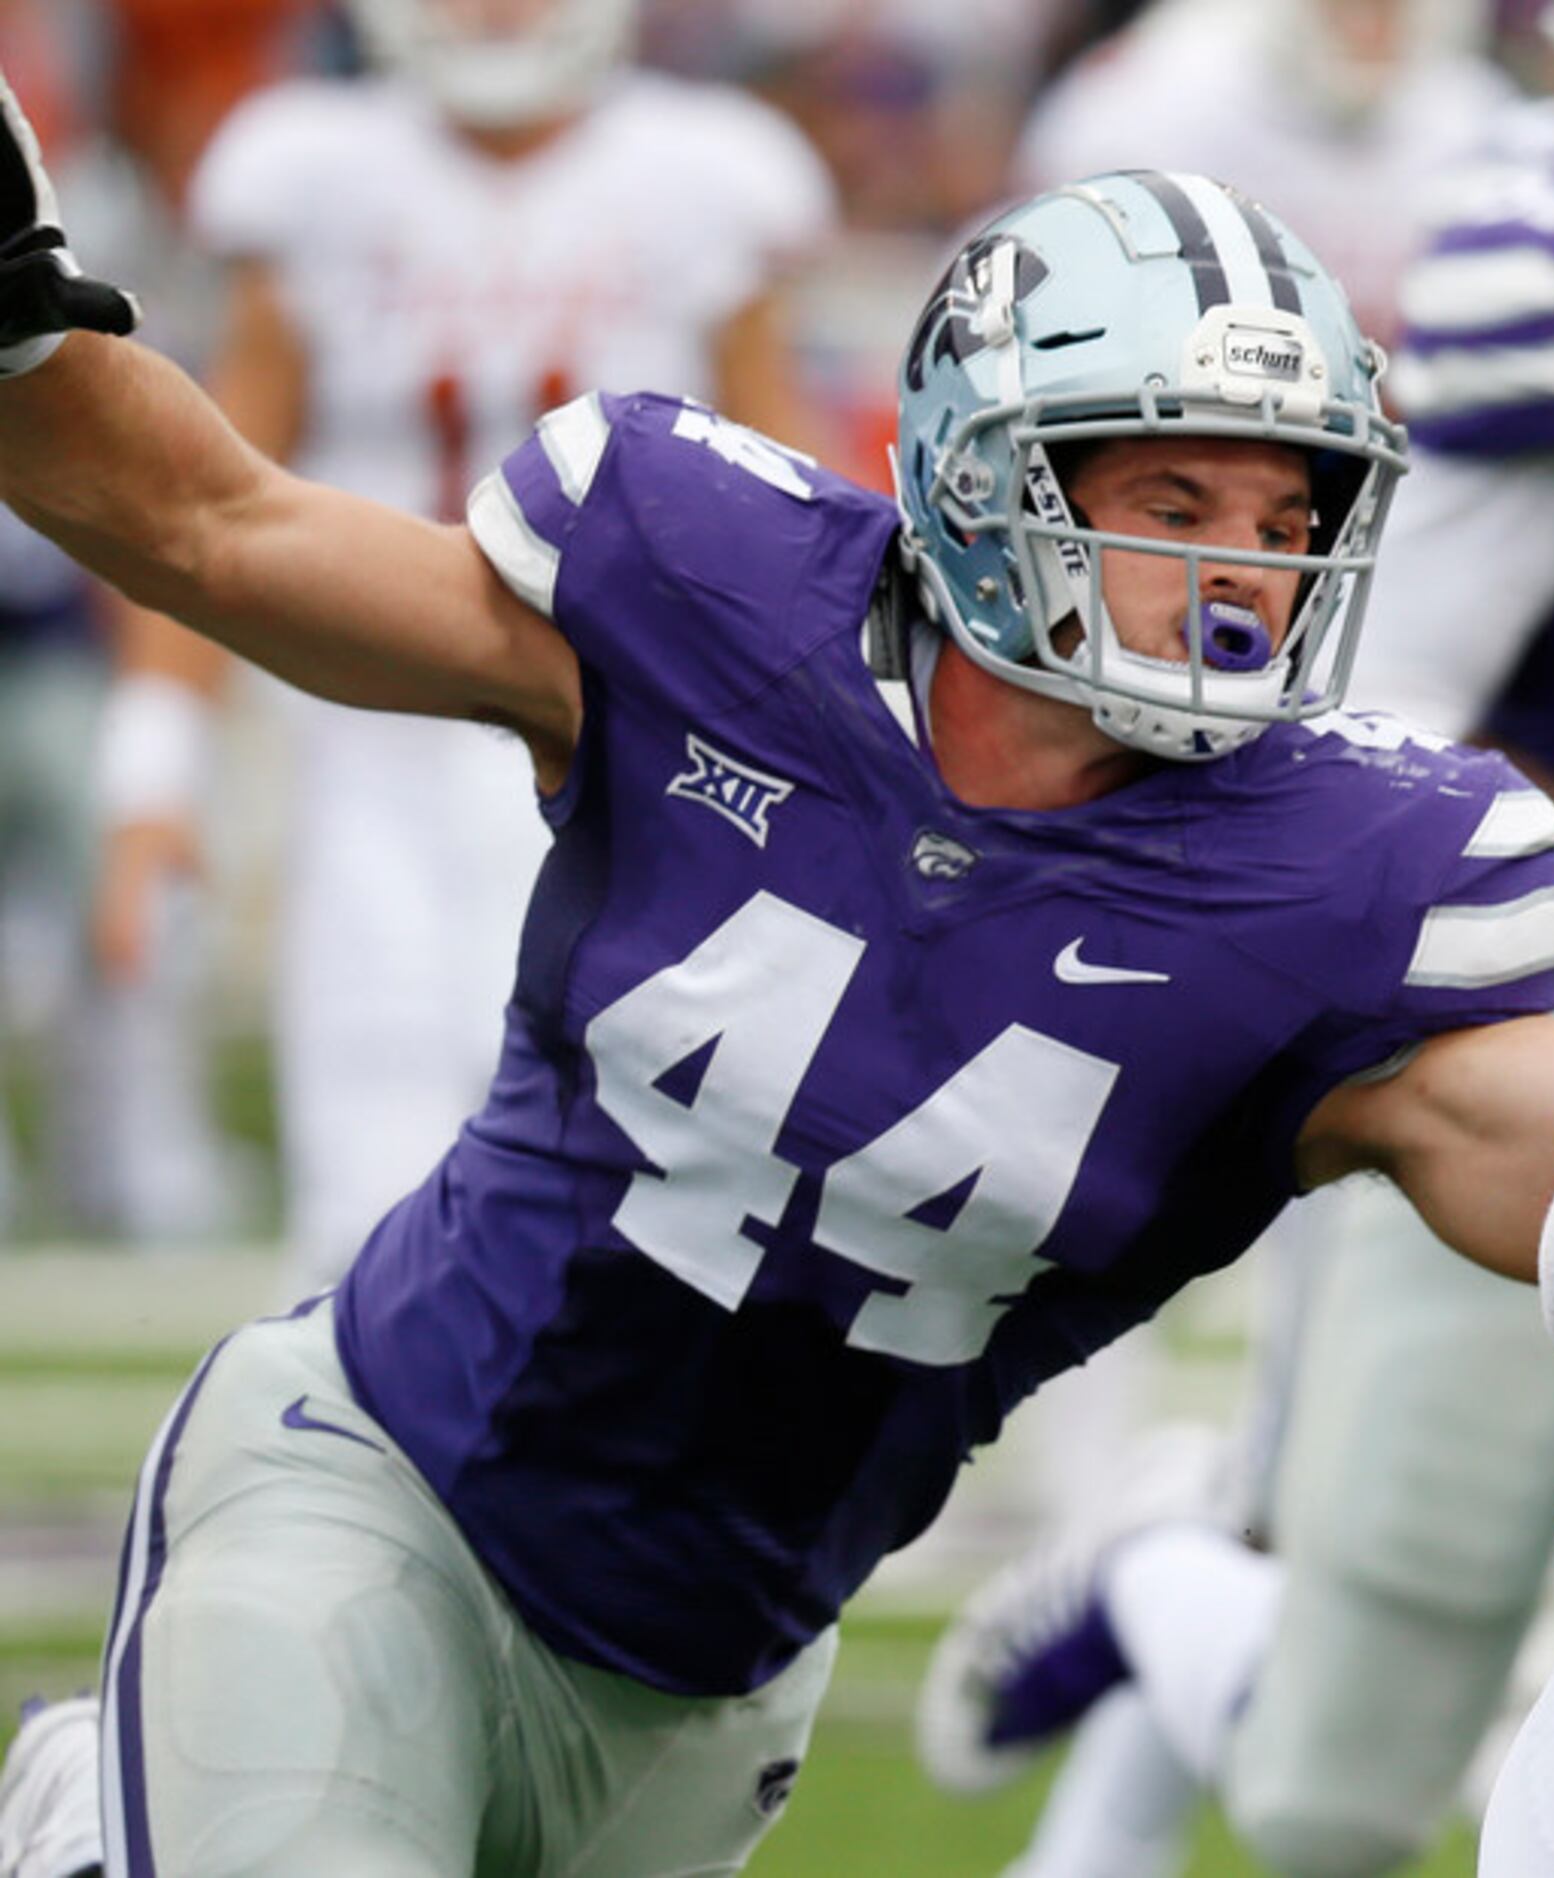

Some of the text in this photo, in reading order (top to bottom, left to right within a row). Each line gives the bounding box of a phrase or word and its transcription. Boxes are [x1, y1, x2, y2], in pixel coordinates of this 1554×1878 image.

[1228, 345, 1300, 371] schutt
[1026, 465, 1089, 577] K-STTE
[585, 888, 1123, 1366] 44
